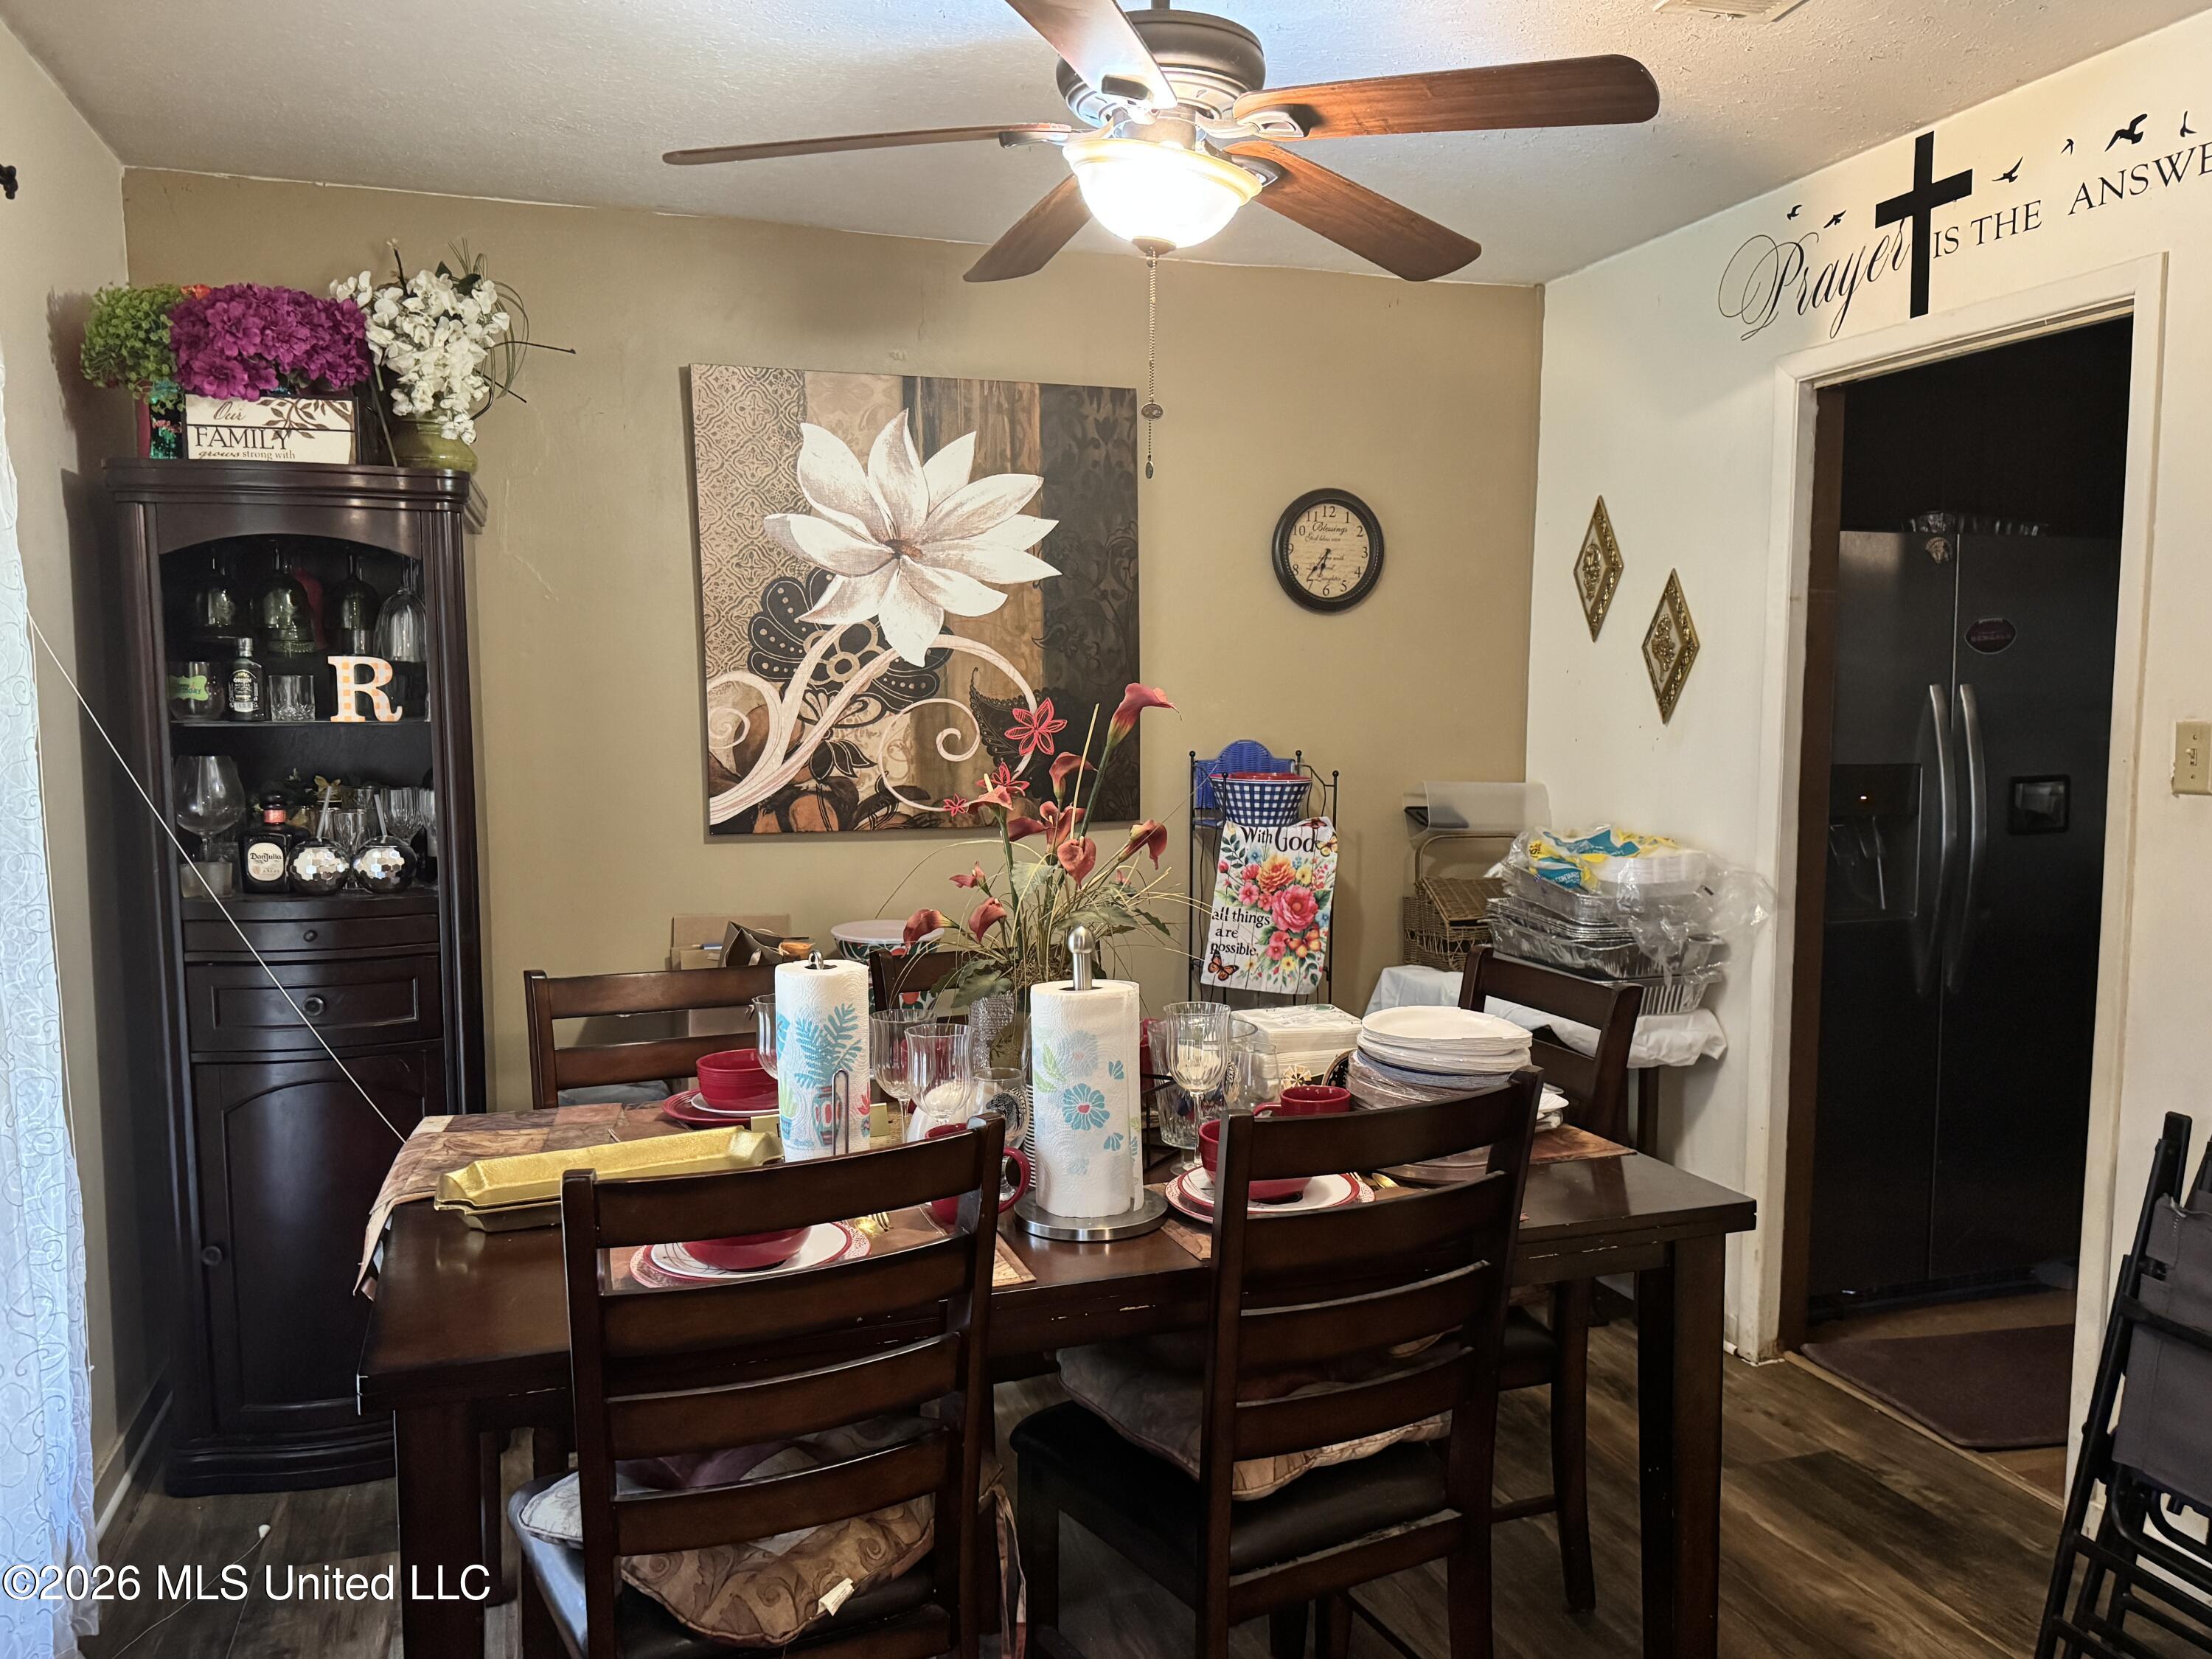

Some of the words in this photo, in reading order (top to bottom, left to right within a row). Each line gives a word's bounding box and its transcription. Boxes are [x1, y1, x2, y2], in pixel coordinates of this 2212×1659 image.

[1719, 217, 1910, 341] Prayer
[1933, 227, 1959, 259] IS
[1971, 200, 2042, 246] THE
[213, 401, 247, 421] Our
[195, 425, 293, 450] FAMILY
[198, 451, 240, 460] grows
[242, 451, 274, 461] strong
[274, 450, 296, 460] with
[1306, 511, 1318, 522] 11
[1322, 506, 1336, 518] 12
[1344, 512, 1350, 524] 1
[1293, 525, 1306, 536] 10
[1312, 521, 1348, 535] Blessings
[1356, 526, 1363, 537] 2
[1288, 543, 1294, 555] 9
[1361, 546, 1368, 559] 3
[1293, 564, 1299, 576] 8
[1354, 566, 1362, 578] 4
[1307, 579, 1314, 590] 7
[1323, 584, 1330, 596] 6
[1340, 580, 1347, 592] 5
[327, 655, 403, 723] R
[1240, 827, 1272, 844] With
[1275, 827, 1315, 853] God
[1211, 907, 1228, 922] all
[1232, 908, 1270, 928] things
[1215, 928, 1239, 939] are
[1210, 942, 1259, 956] possible.
